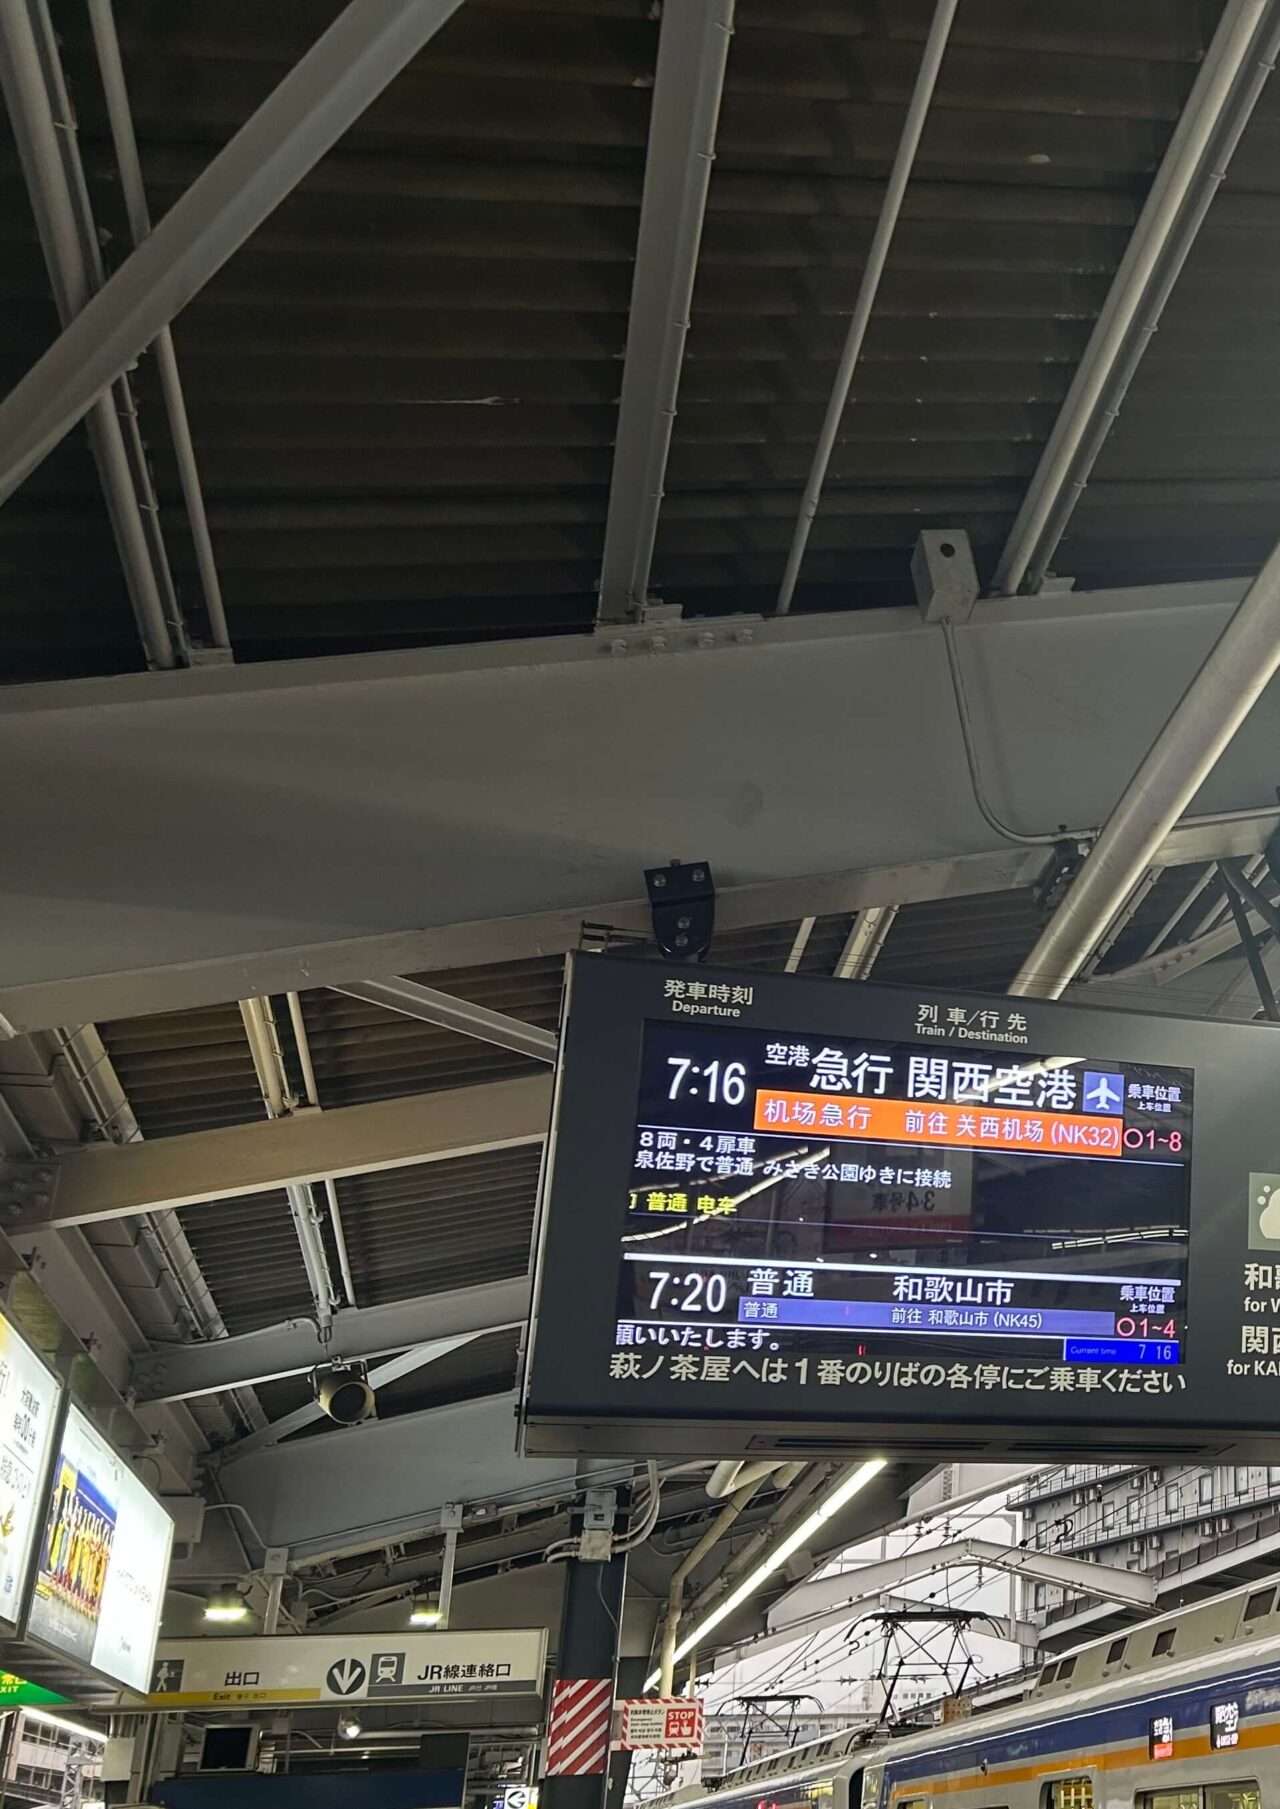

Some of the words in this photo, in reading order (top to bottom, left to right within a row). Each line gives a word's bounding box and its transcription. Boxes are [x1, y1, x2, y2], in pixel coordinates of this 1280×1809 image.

[664, 979, 753, 1005] 発車時刻
[672, 1000, 741, 1018] Departure
[915, 1023, 945, 1037] Train
[958, 1027, 1028, 1044] Destination
[667, 1057, 747, 1106] 7:16
[907, 1056, 1077, 1110] 関西空港
[1127, 1083, 1182, 1102] 乗車位置
[764, 1099, 872, 1130] 机场急行
[905, 1110, 948, 1136] 前往
[955, 1113, 1044, 1142] 关西机场
[1051, 1123, 1119, 1150] (NK32)
[635, 1150, 754, 1177] 泉佐野で普通
[763, 1161, 951, 1189] みさき公園ゆきに接続
[646, 1192, 688, 1212] 普通
[649, 1271, 727, 1313] 7:20
[747, 1268, 815, 1298] 普通
[893, 1275, 1015, 1306] 和歌山市
[1120, 1284, 1176, 1303] 乗車位置
[1244, 1297, 1268, 1313] for
[743, 1302, 779, 1319] 普通
[891, 1307, 922, 1325] 前往
[928, 1308, 989, 1327] 和歌山市
[994, 1312, 1043, 1330] (NK45)
[1226, 1360, 1250, 1376] for
[224, 1671, 260, 1686] 出口
[417, 1663, 511, 1680] JR線連絡口
[213, 1692, 231, 1700] Exit
[443, 1685, 464, 1693] LINE
[668, 1711, 694, 1720] STOP
